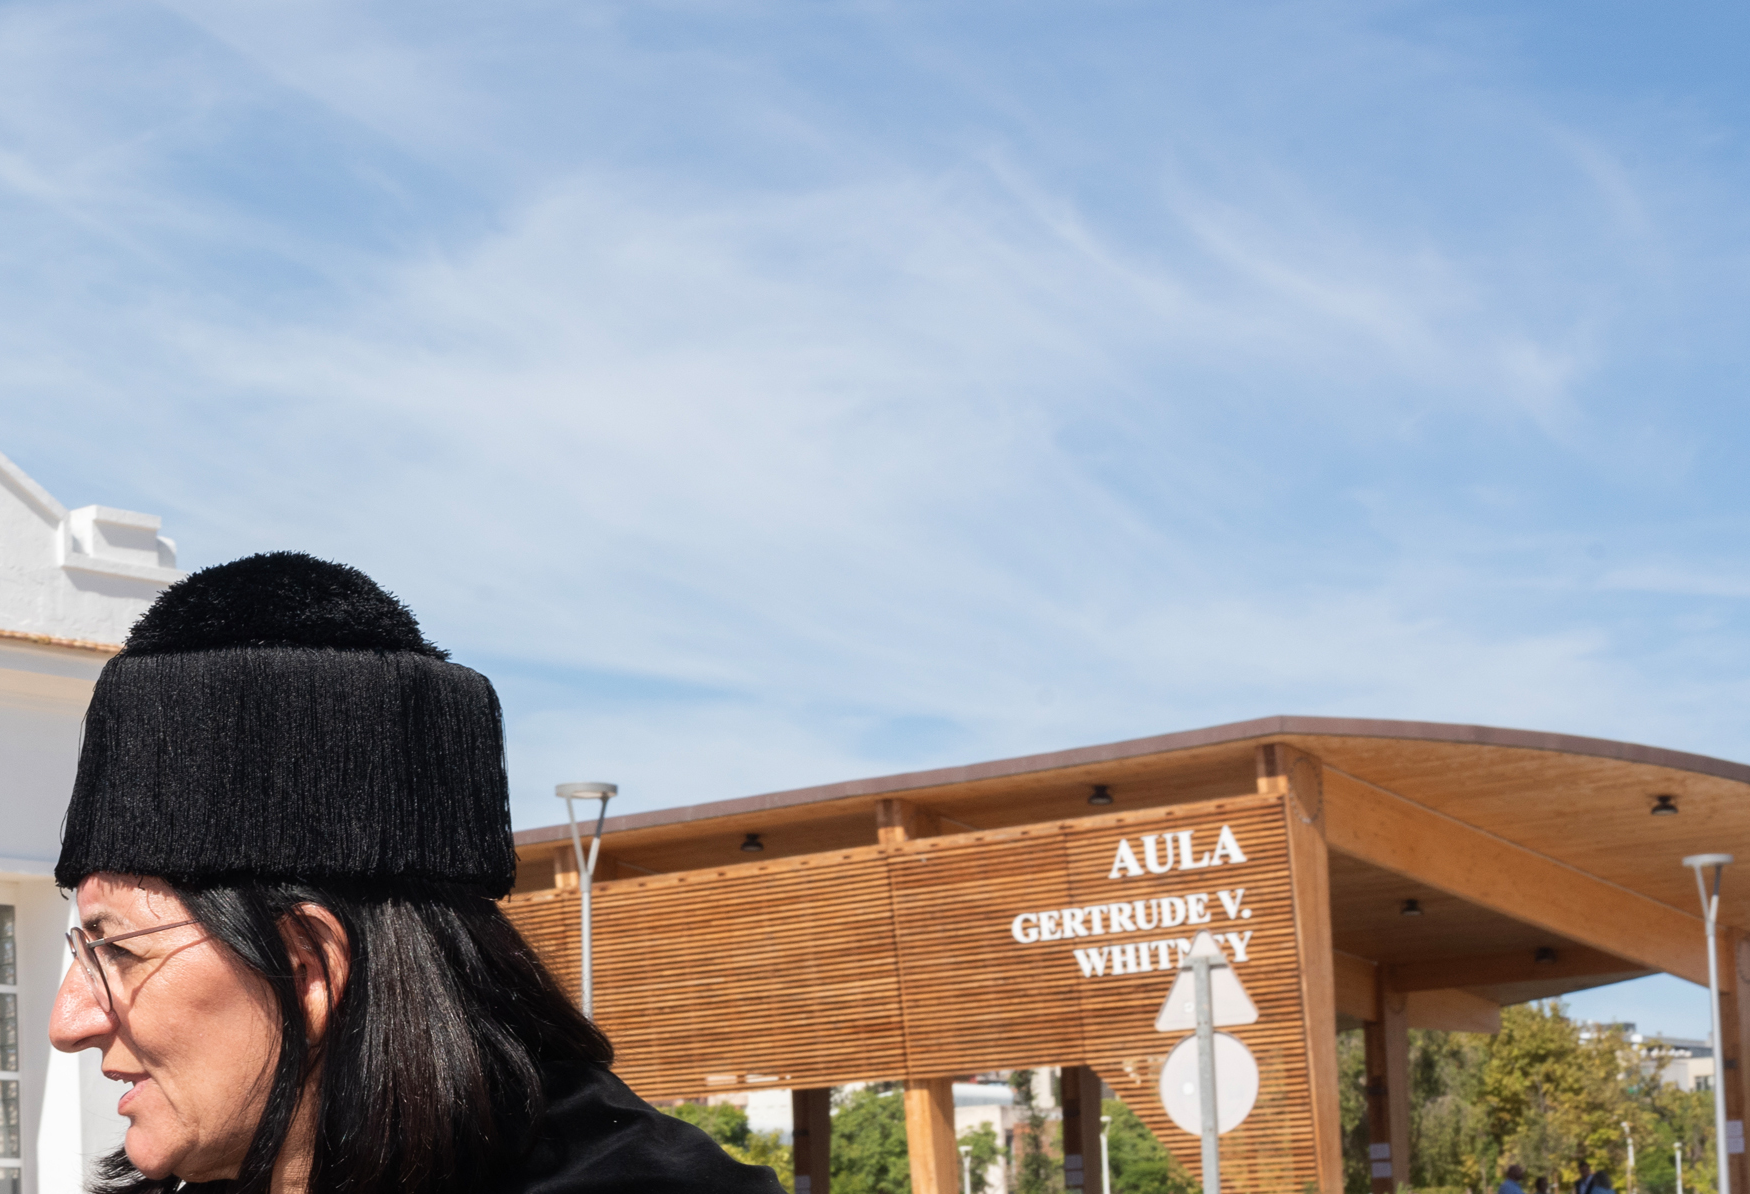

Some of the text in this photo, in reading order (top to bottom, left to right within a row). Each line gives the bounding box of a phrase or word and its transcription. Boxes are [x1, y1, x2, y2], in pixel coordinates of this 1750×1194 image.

[1108, 824, 1248, 879] AULA
[1011, 888, 1253, 944] GERTRUDE V.
[1073, 930, 1253, 978] WHITNY
